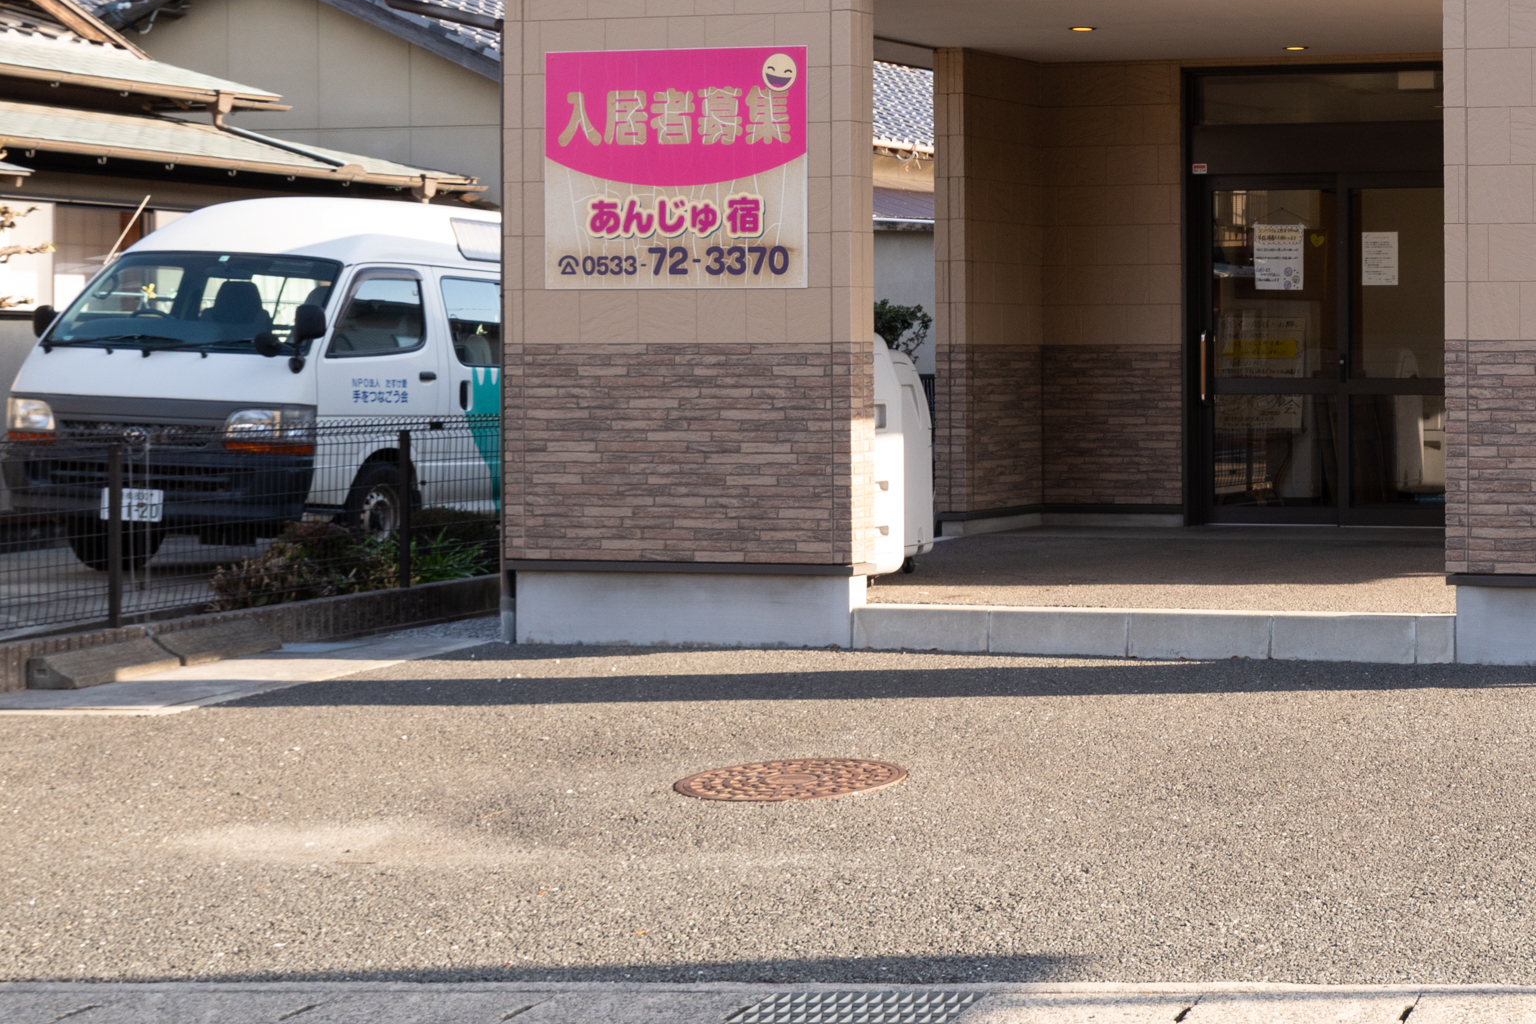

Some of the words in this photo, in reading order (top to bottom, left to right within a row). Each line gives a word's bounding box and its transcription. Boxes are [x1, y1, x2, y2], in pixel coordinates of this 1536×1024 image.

[557, 85, 791, 147] 入居者募集
[588, 194, 763, 236] あんじゅ宿
[581, 245, 790, 276] 0533-72-3370
[352, 390, 409, 403] 手をつなごう会
